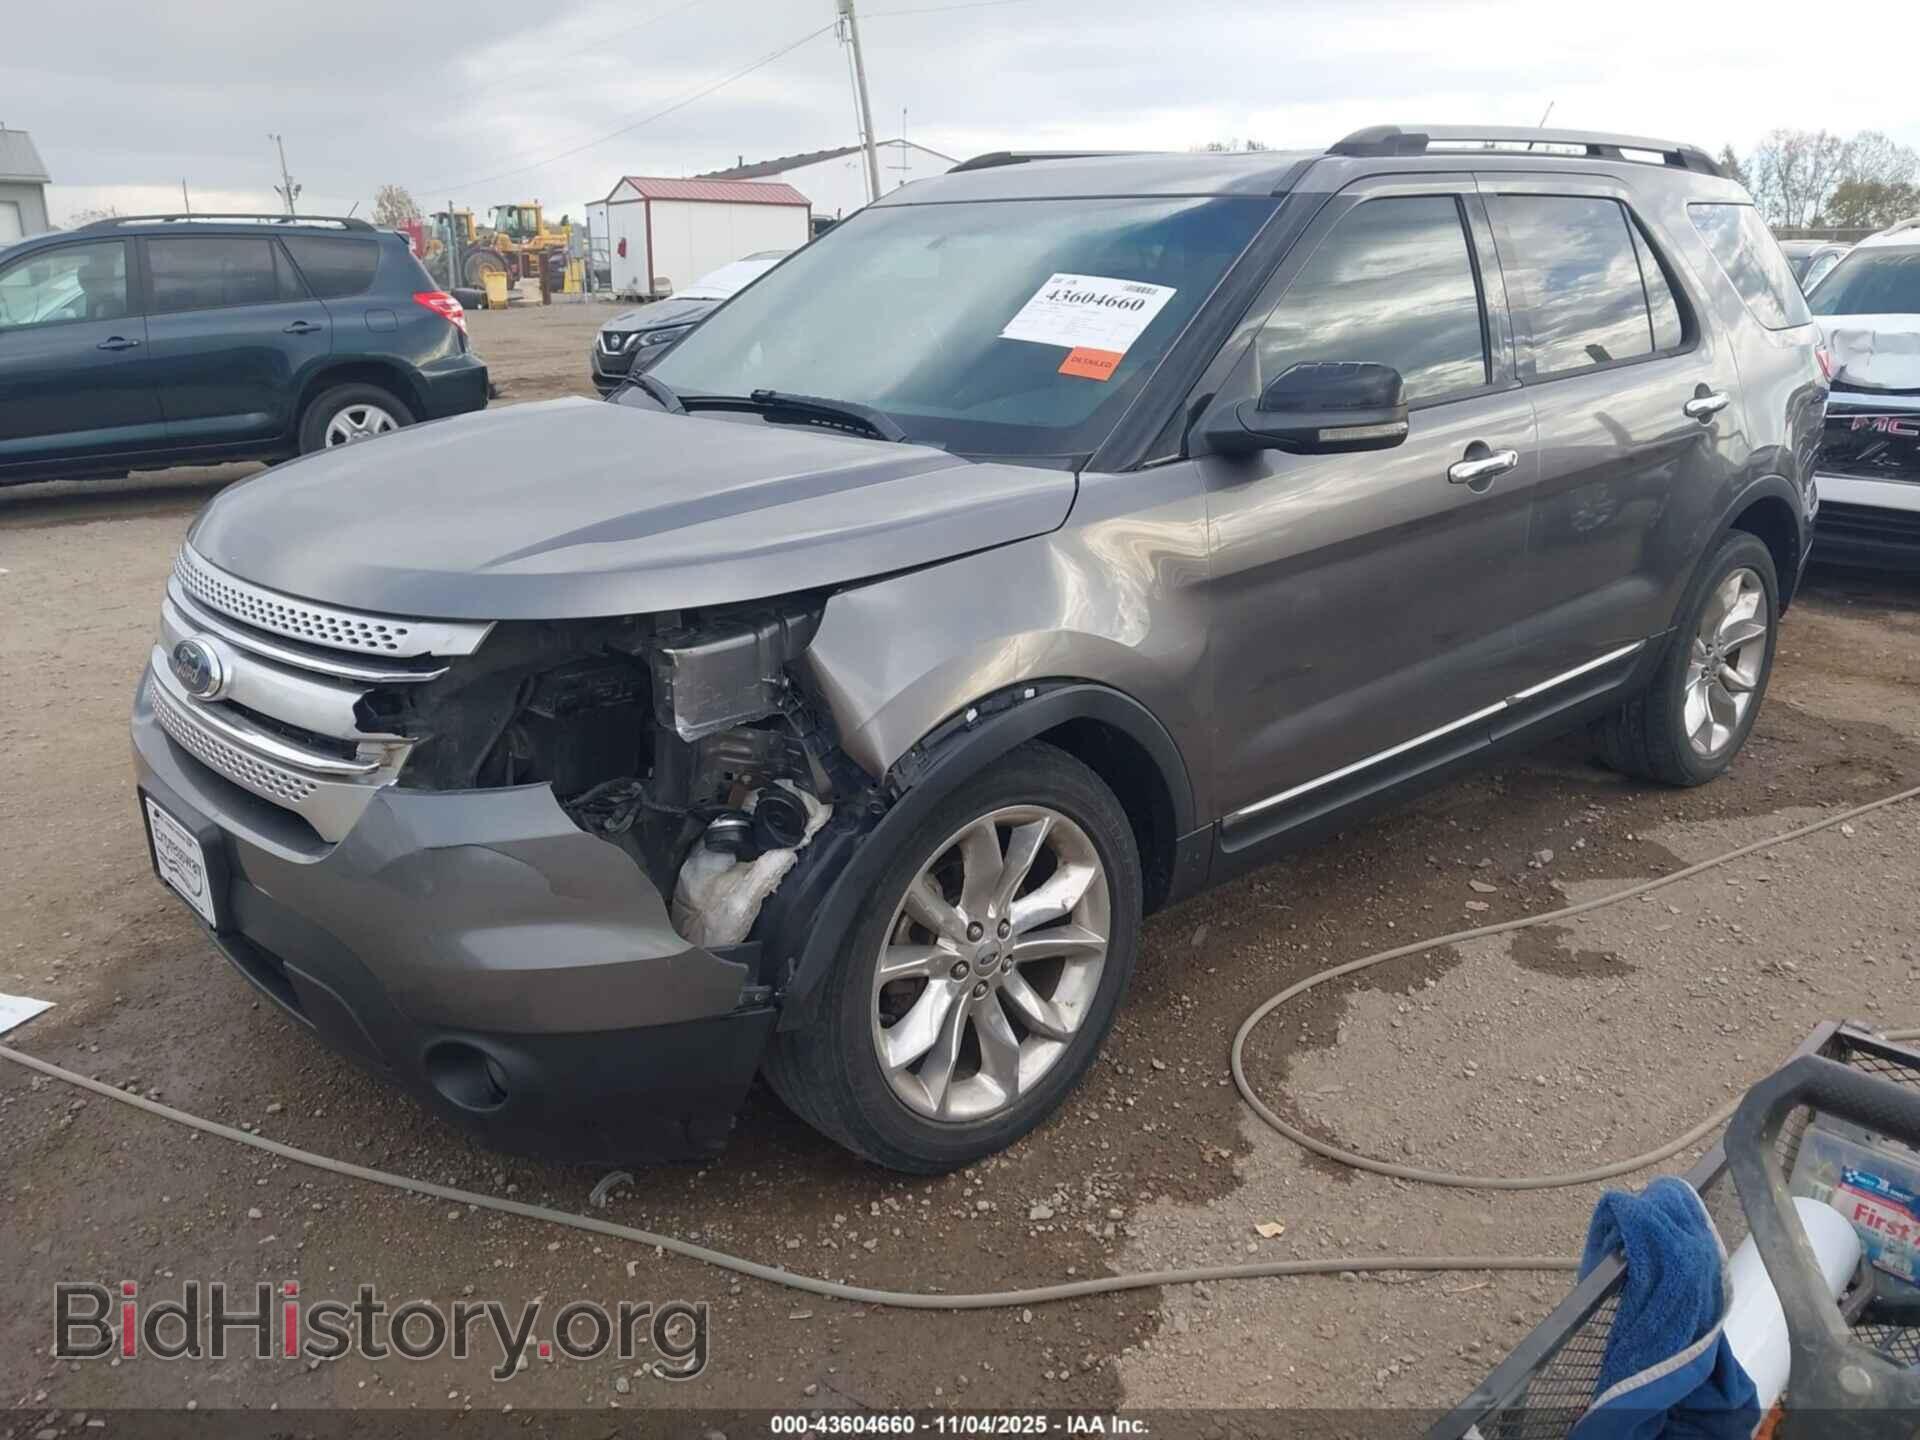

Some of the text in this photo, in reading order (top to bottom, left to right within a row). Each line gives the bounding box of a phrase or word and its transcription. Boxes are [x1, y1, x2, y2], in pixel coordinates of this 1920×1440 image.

[1046, 289, 1145, 312] 43604660
[1070, 356, 1113, 369] DETAILED
[1854, 1203, 1910, 1239] First
